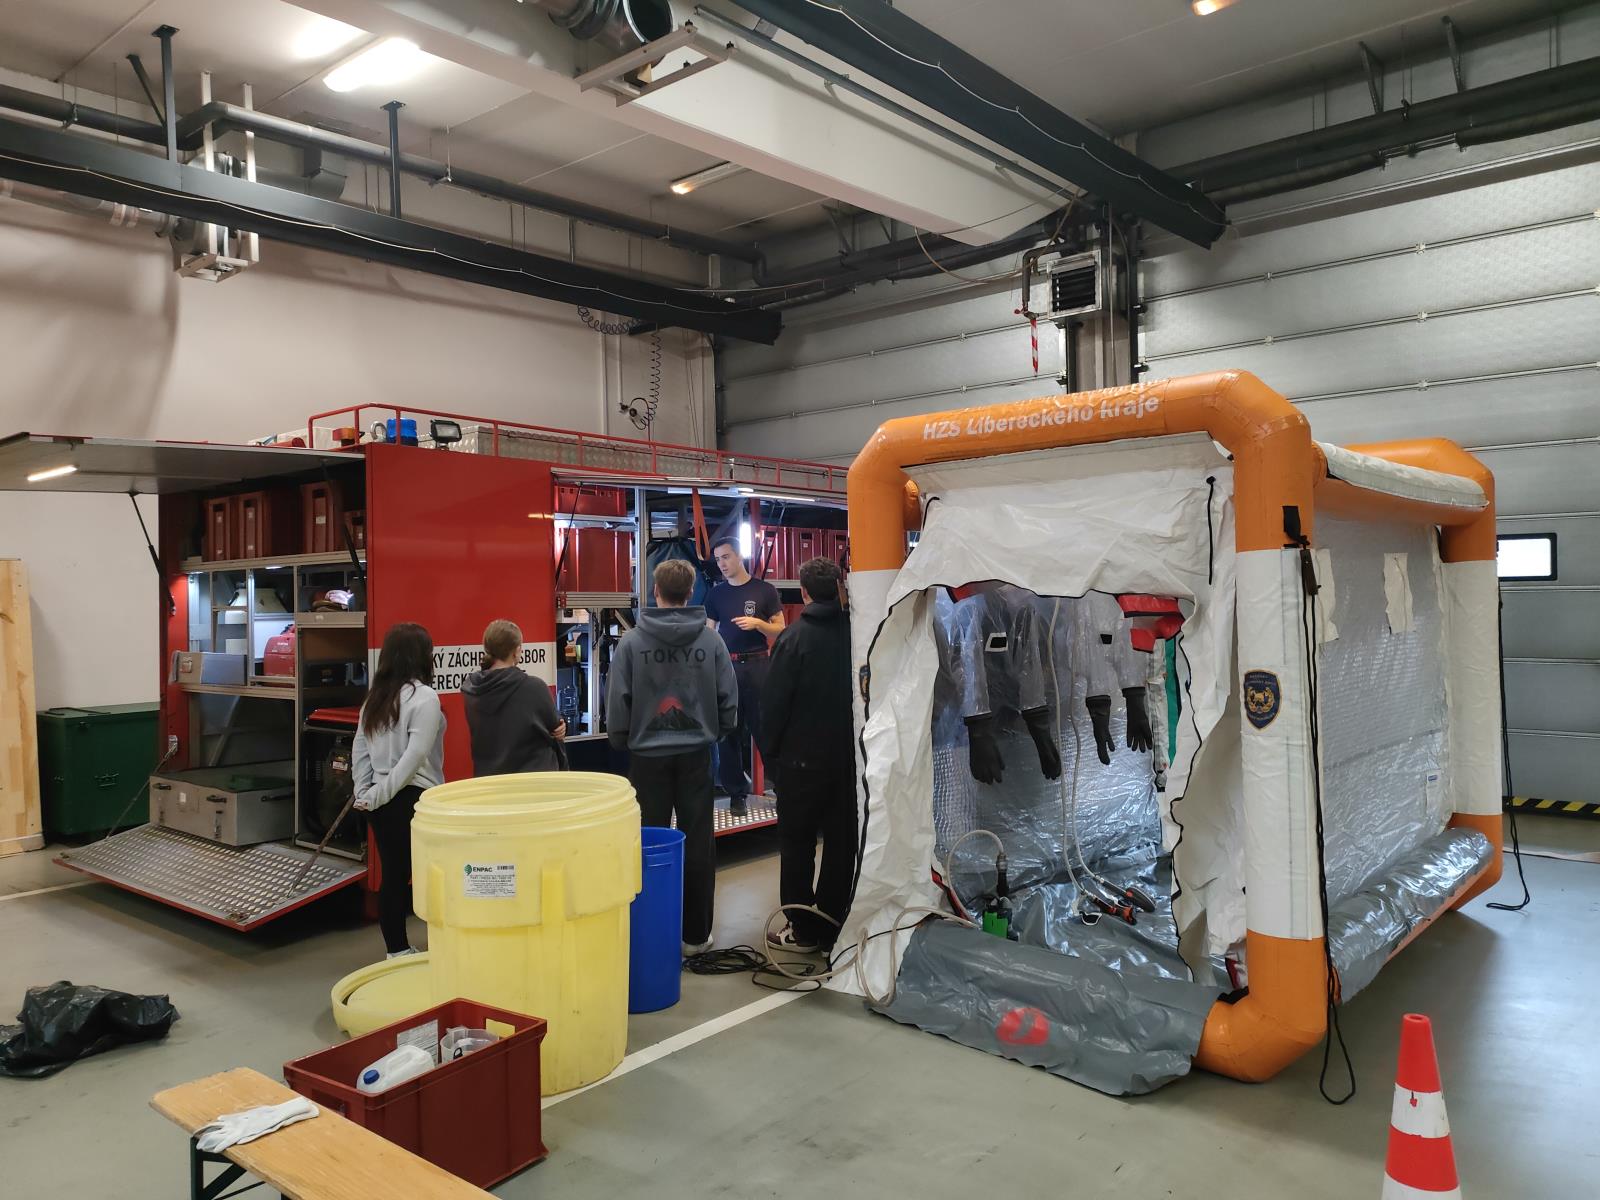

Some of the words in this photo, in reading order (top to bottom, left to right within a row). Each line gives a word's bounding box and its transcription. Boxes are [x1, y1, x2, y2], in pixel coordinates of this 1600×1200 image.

[923, 420, 960, 440] HZS
[1100, 395, 1159, 419] kraje
[640, 648, 706, 664] TOKYO
